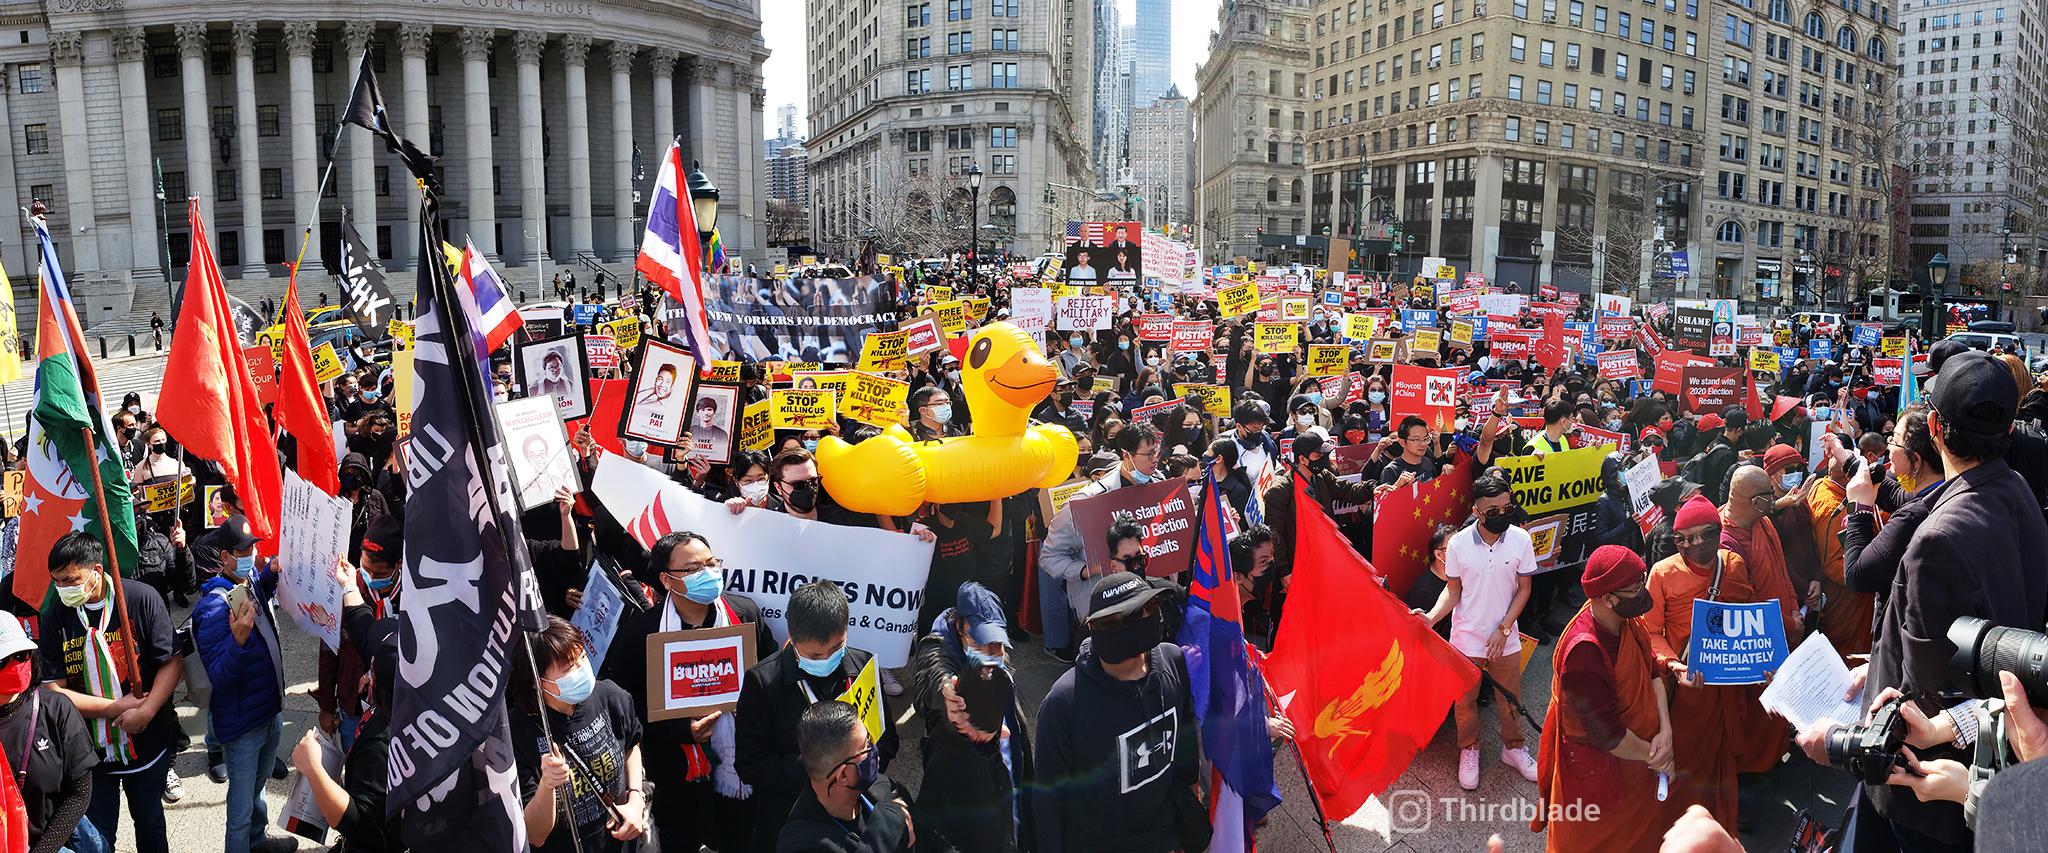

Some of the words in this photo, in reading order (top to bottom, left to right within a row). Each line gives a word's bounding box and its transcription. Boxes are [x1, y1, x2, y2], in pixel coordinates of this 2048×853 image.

[543, 4, 592, 16] HOUSE
[1223, 296, 1246, 306] KILLING
[1246, 293, 1254, 301] US
[1226, 288, 1248, 300] STOP
[1451, 295, 1478, 303] JUSTICE
[584, 305, 598, 313] UN
[1067, 298, 1105, 309] REJECT
[707, 309, 734, 323] NEW
[735, 314, 794, 326] YORKERS
[796, 315, 822, 326] FOR
[824, 311, 898, 326] DEMOCRACY
[938, 306, 962, 318] FREE
[1060, 308, 1109, 319] MILITARY
[1414, 311, 1430, 321] UN
[1017, 316, 1044, 329] WITH
[1072, 318, 1098, 329] COUP
[1353, 315, 1370, 323] COUP
[1677, 314, 1712, 327] SHAME
[616, 322, 638, 334] FREE
[1265, 327, 1287, 335] STOP
[1488, 320, 1517, 331] BURMA
[1575, 324, 1589, 332] UN
[1601, 324, 1633, 332] JUSTICE
[1173, 330, 1211, 340] JUSTICE
[1351, 331, 1367, 339] FAIL
[1864, 328, 1877, 338] UN
[878, 338, 905, 350] STOP
[1640, 328, 1661, 353] BURMA
[1818, 340, 1829, 348] UN
[1493, 341, 1527, 352] BURMA
[1583, 344, 1597, 353] UN
[1782, 348, 1794, 356] UN
[869, 349, 899, 357] KILLING
[1318, 350, 1341, 358] STOP
[1599, 359, 1637, 370] JUSTICE
[1395, 380, 1423, 390] #Boycott
[1688, 377, 1700, 385] We
[1700, 377, 1720, 386] stand
[1721, 377, 1736, 386] with
[857, 381, 892, 398] STOP
[1395, 389, 1416, 398] #China
[1689, 387, 1707, 395] 2020
[1707, 388, 1734, 396] Election
[786, 396, 819, 406] STOP
[849, 392, 884, 407] KILLING
[884, 400, 897, 409] US
[1698, 397, 1723, 406] Results
[780, 406, 814, 414] KILLING
[814, 406, 825, 414] US
[650, 412, 665, 421] FREE
[649, 418, 663, 428] PAI
[1512, 486, 1553, 507] ONG
[1135, 503, 1164, 520] stand
[1162, 497, 1186, 513] with
[859, 615, 871, 628] &
[1723, 608, 1765, 638] UN
[103, 631, 123, 643] CIVIL
[1701, 637, 1728, 650] TAKE
[1732, 637, 1773, 651] ACTION
[1699, 649, 1776, 665] IMMEDIATELY
[672, 662, 735, 681] BURMA
